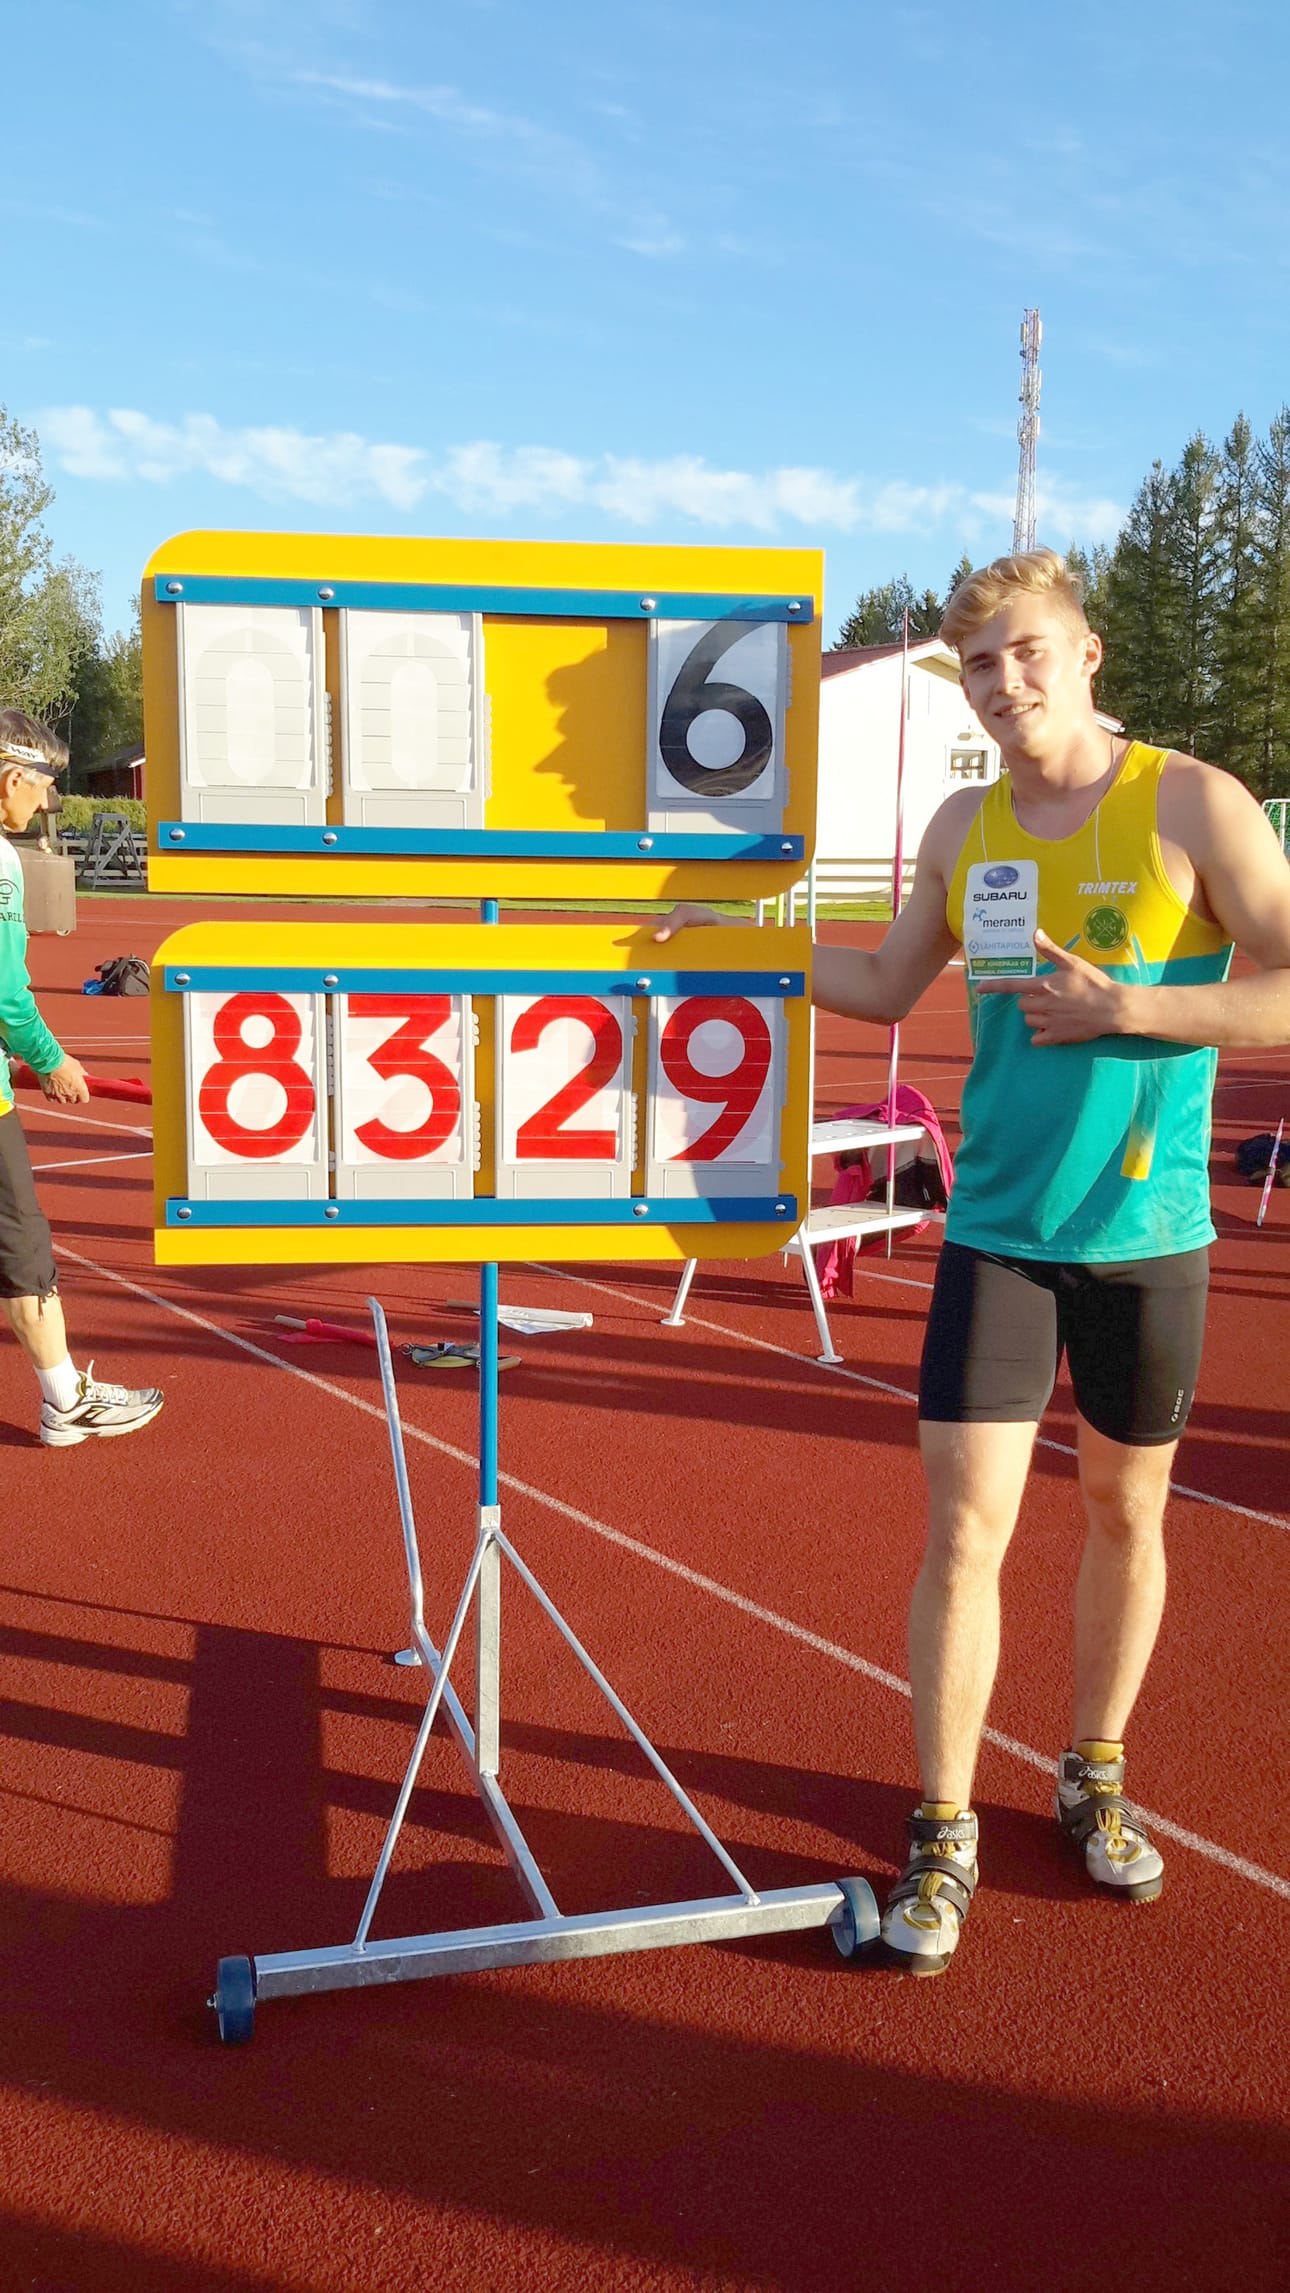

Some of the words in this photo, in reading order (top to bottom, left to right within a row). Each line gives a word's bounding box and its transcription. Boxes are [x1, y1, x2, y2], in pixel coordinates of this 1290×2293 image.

[659, 618, 773, 797] 6
[1077, 881, 1138, 895] TRIMTEX
[973, 891, 1027, 902] SUBARU
[982, 916, 1025, 928] meranti
